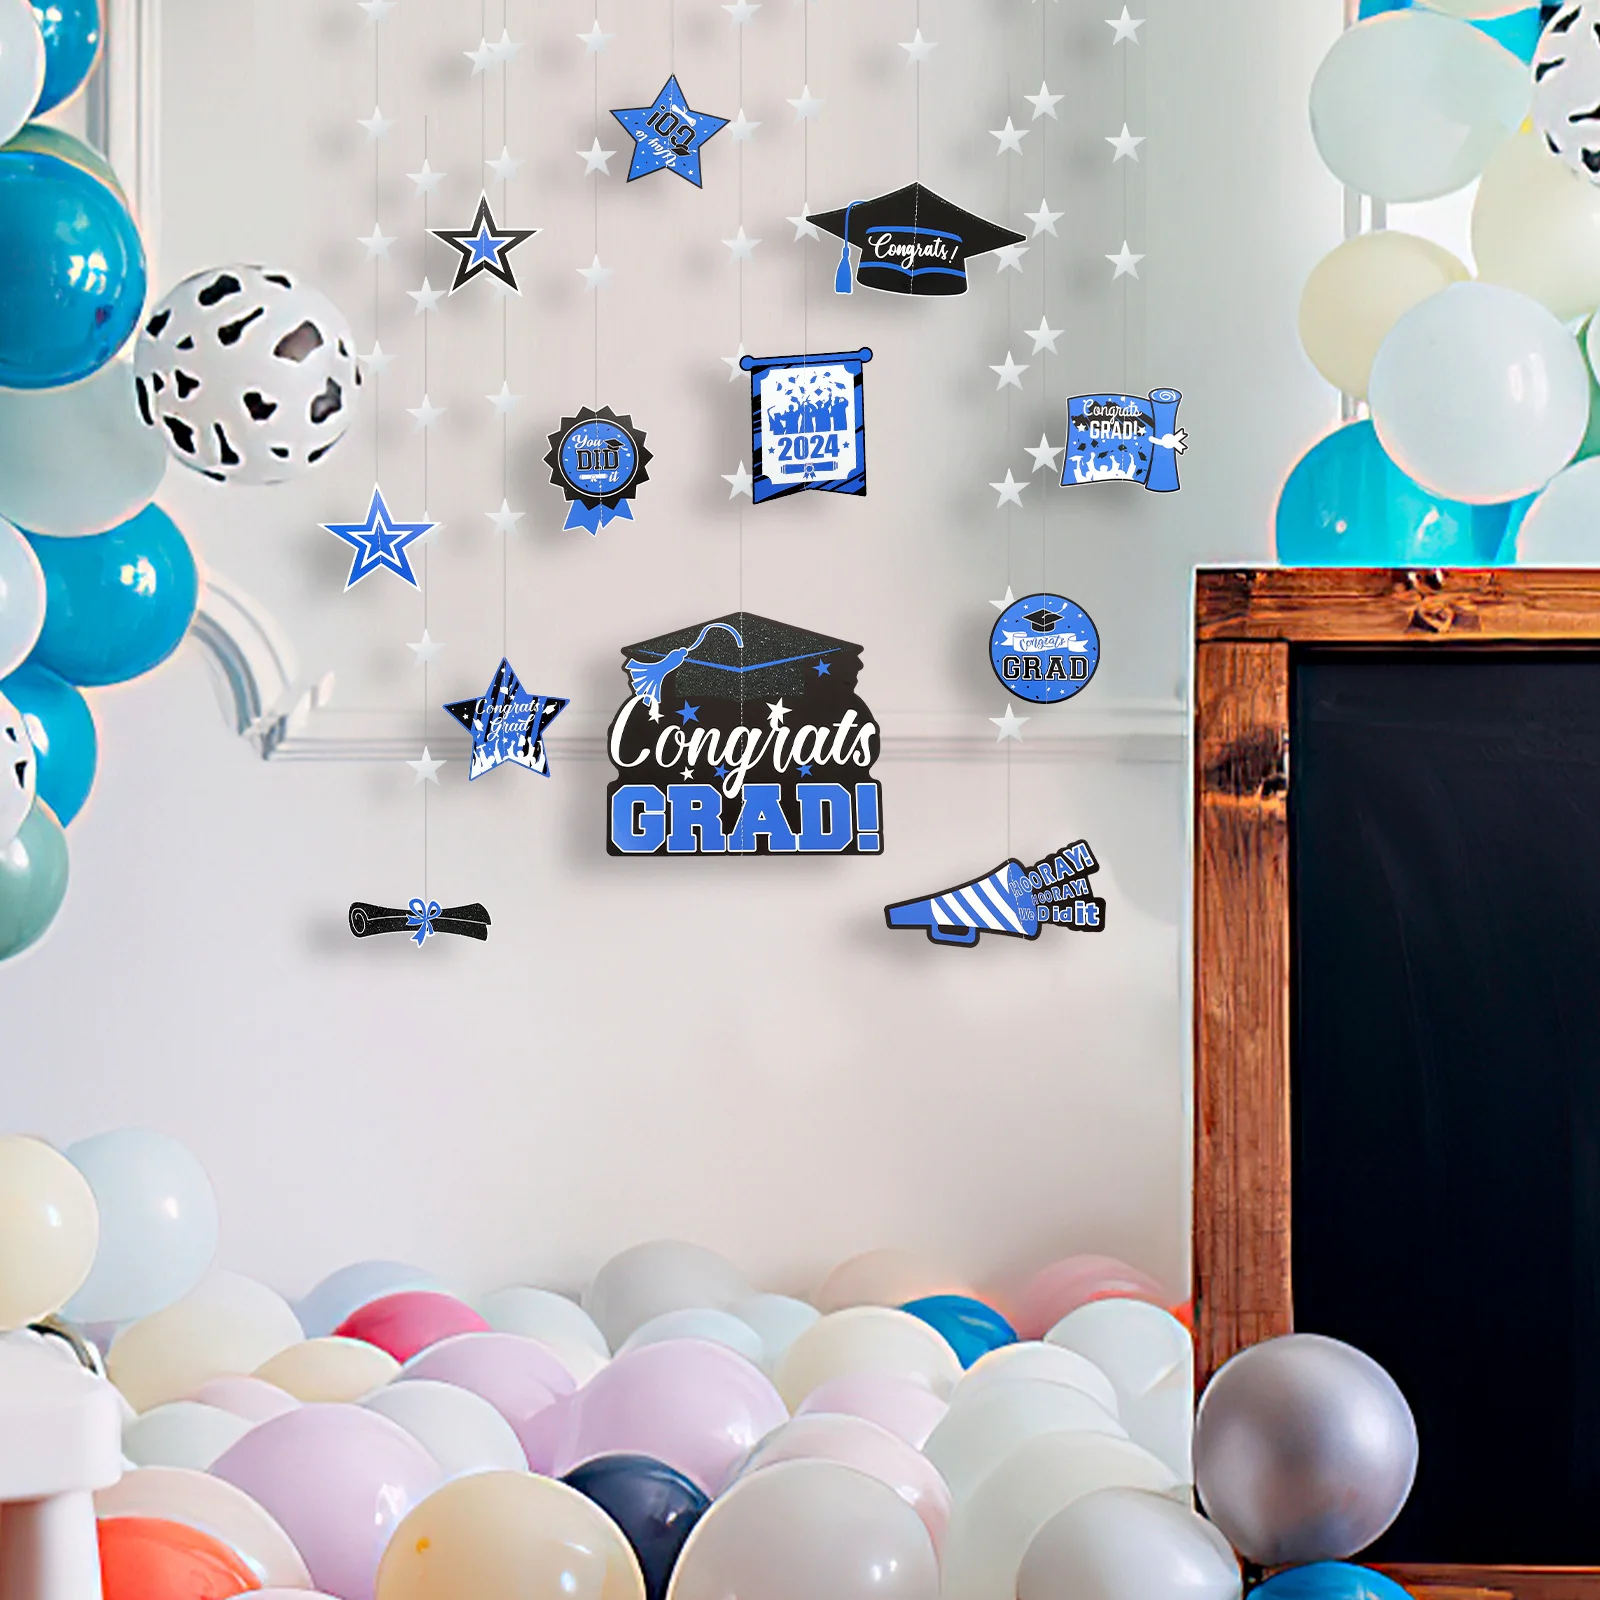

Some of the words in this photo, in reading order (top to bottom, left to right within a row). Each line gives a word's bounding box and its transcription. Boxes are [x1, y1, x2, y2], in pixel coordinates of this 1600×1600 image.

[645, 103, 697, 148] GO!
[868, 232, 959, 270] Congrats!
[1083, 398, 1143, 425] Congrats
[571, 434, 605, 449] You
[1089, 420, 1138, 440] GRAD!
[576, 448, 620, 471] DID
[777, 433, 841, 462] 2024
[608, 470, 620, 483] it
[1019, 635, 1067, 652] Congrats
[1002, 654, 1089, 681] GRAD
[475, 698, 540, 720] Congrats
[486, 714, 535, 742] Grad
[610, 693, 876, 800] Congrats
[611, 783, 880, 853] GRAD!
[1008, 842, 1095, 898] HOORAY!
[1030, 878, 1089, 906] HOORAY!
[1018, 907, 1036, 921] We
[1075, 900, 1100, 926] it
